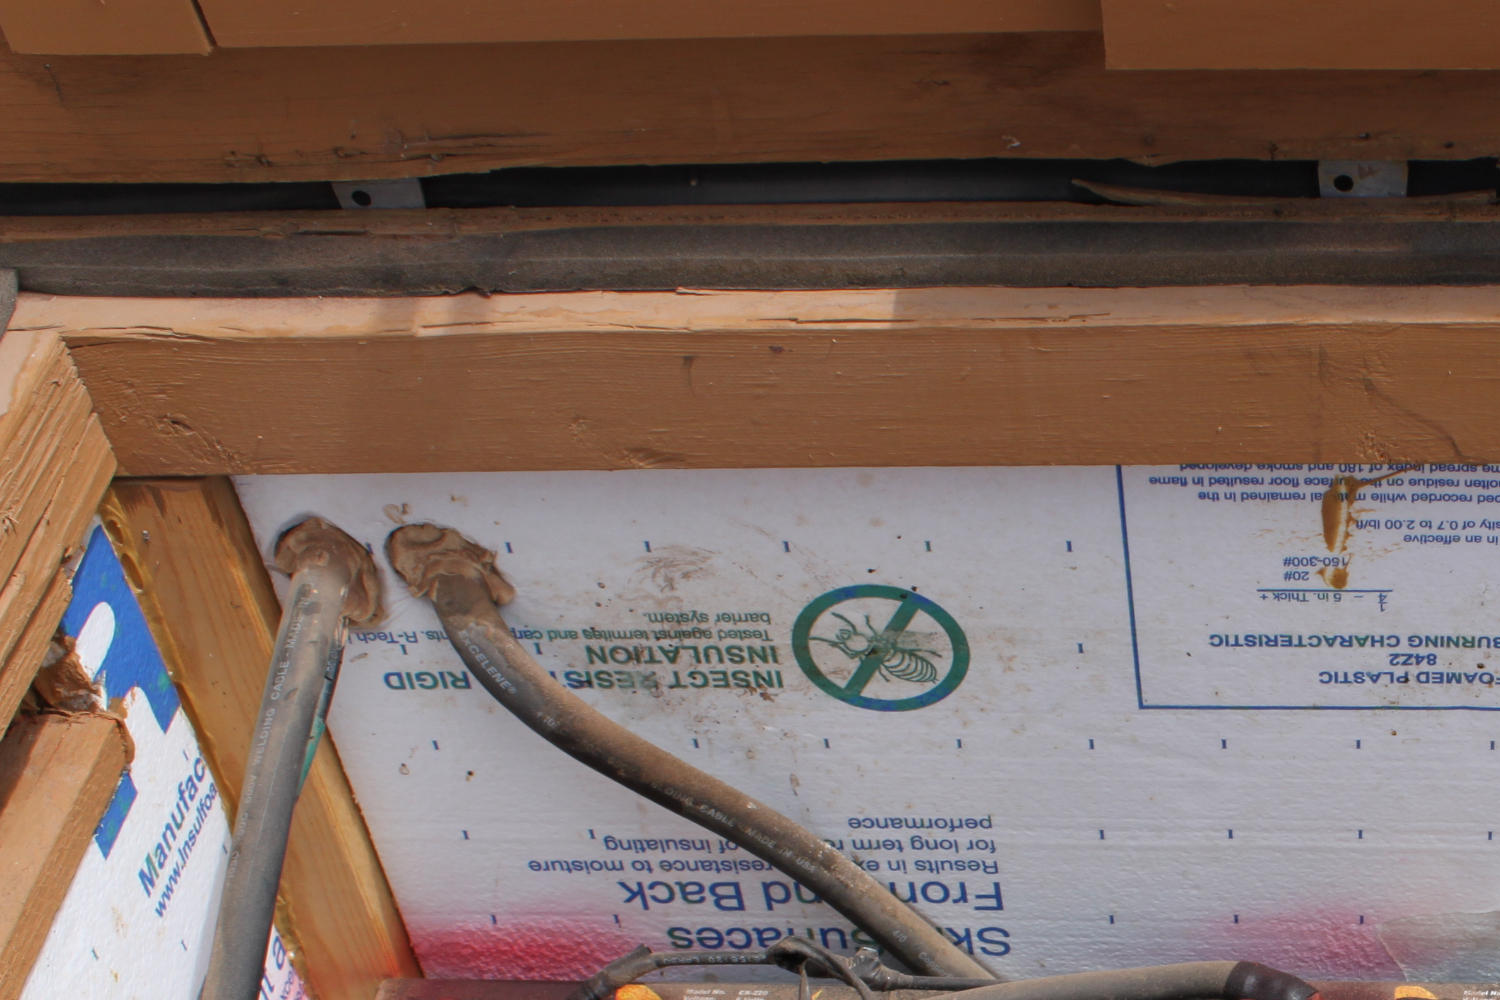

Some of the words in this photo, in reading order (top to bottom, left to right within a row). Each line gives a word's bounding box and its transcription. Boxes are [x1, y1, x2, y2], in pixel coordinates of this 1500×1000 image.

[1149, 475, 1187, 487] flame
[1190, 476, 1206, 487] in
[1208, 476, 1264, 488] resulted
[1269, 476, 1303, 489] floor
[1386, 480, 1407, 490] on
[1409, 478, 1463, 490] residue
[1197, 490, 1219, 500] the
[1223, 490, 1237, 501] in
[1241, 490, 1306, 502] remained
[1371, 492, 1407, 504] while
[1410, 492, 1473, 504] recorded
[1384, 520, 1416, 530] 2.00
[1420, 520, 1433, 530] to
[1437, 520, 1458, 530] 0.7
[1463, 520, 1477, 531] of
[1403, 534, 1461, 545] effective
[1466, 536, 1482, 544] an
[1484, 535, 1499, 545] in
[1283, 555, 1348, 568] 150-300#
[1283, 571, 1310, 582] 20#
[1273, 592, 1309, 602] Thick
[644, 610, 710, 625] system.
[714, 612, 771, 624] barrier
[356, 628, 419, 645] R-Tech
[548, 627, 579, 640] and
[582, 627, 651, 641] termites
[655, 627, 722, 641] against
[727, 628, 774, 641] Tested
[1209, 633, 1400, 648] CHARACTERISTIC
[585, 644, 779, 664] INSULATION
[1388, 653, 1437, 666] 84Z2
[382, 670, 472, 690] RIGID
[671, 670, 784, 688] INSECT
[1318, 670, 1409, 684] PLASTIC
[137, 756, 208, 898] Manufac
[847, 816, 993, 832] performance
[603, 835, 712, 855] insulating
[713, 838, 740, 853] of
[851, 839, 904, 852] term
[910, 836, 961, 854] long
[967, 838, 997, 854] for
[527, 858, 627, 874] moisture
[632, 859, 654, 872] to
[659, 859, 773, 873] resistance
[888, 859, 913, 874] in
[919, 859, 999, 875] Results
[622, 880, 747, 912] Back
[888, 880, 1004, 912] Fron
